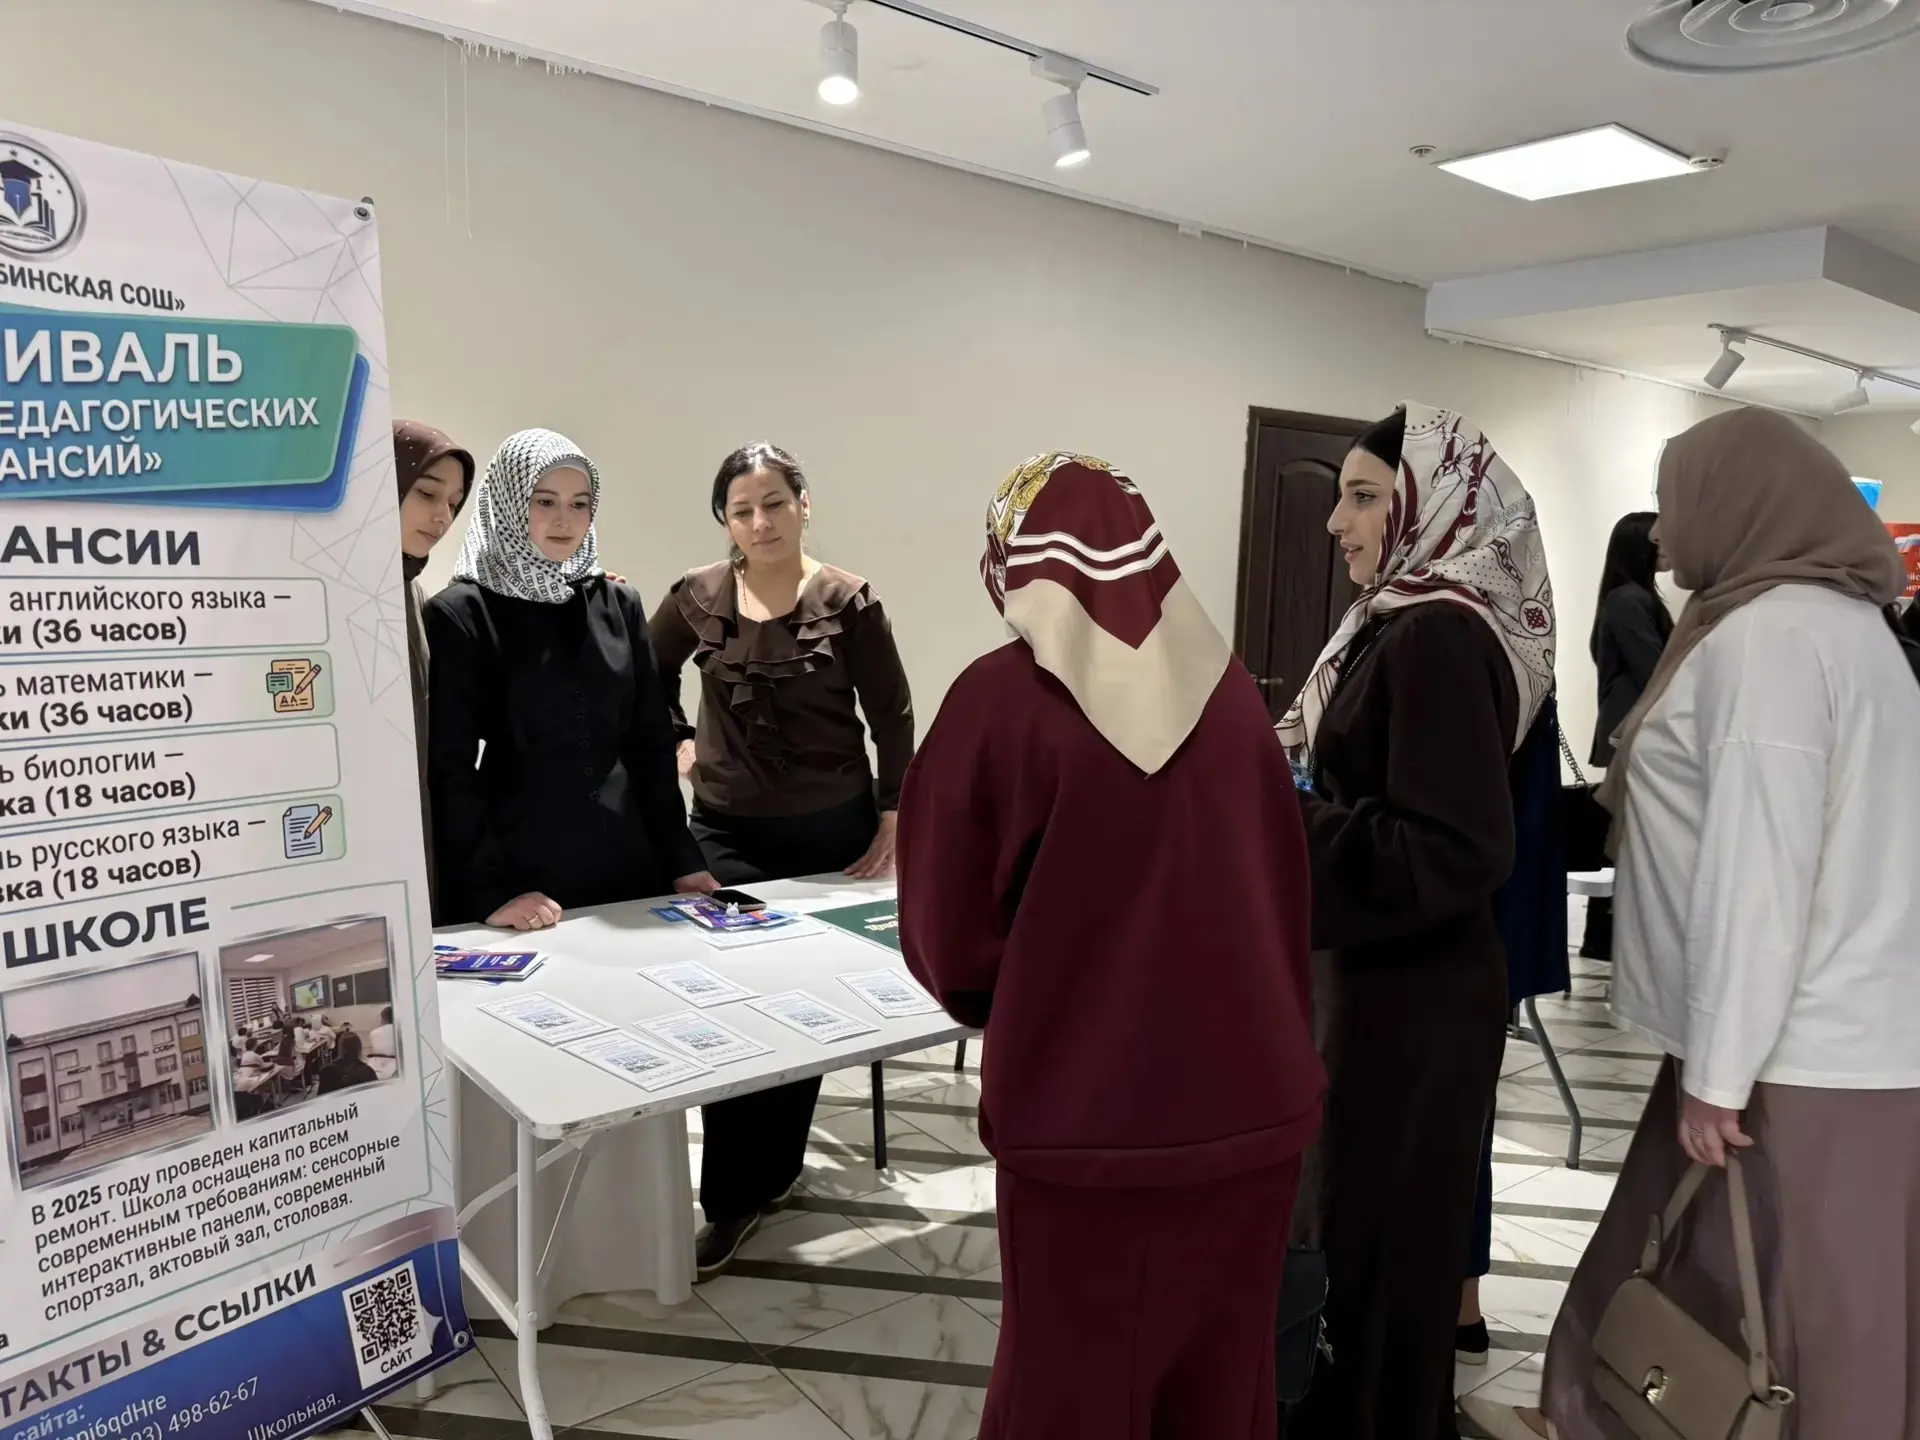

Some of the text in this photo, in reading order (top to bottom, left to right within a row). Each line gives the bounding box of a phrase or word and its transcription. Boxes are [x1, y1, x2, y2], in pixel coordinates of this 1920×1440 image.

[120, 283, 186, 311] СОШ»
[4, 328, 243, 384] ИВАЛЬ
[0, 435, 163, 482] АНСИЙ»
[0, 525, 201, 566] АНСИИ
[9, 585, 183, 612] английского
[191, 590, 267, 610] языка
[32, 618, 82, 650] (36
[90, 616, 187, 646] часов)
[16, 670, 186, 697] математики
[40, 701, 89, 733] (36
[97, 694, 193, 723] часов)
[24, 751, 156, 781] биологии
[45, 784, 92, 817] (18
[101, 772, 196, 805] часов)
[32, 831, 155, 872] русского
[162, 819, 241, 847] языка
[53, 866, 99, 900] (18
[108, 850, 202, 885] часов)
[3, 896, 210, 969] ШКОЛЕ
[31, 1102, 359, 1225] В 2025 году проведен капитальный
[35, 1129, 349, 1254] ремонт. Школа оснащена по всем
[38, 1135, 400, 1273] современным требованиям: сенсорные
[41, 1156, 386, 1298] интерактивные панели, современный
[44, 1192, 353, 1321] спортзал, актовый зал, столовая.
[143, 1328, 166, 1357] &
[174, 1263, 317, 1342] ССЫЛКИ
[380, 1347, 413, 1374] САЙТ
[168, 1376, 259, 1433] 498-62-67
[247, 1392, 342, 1440] Школьная.
